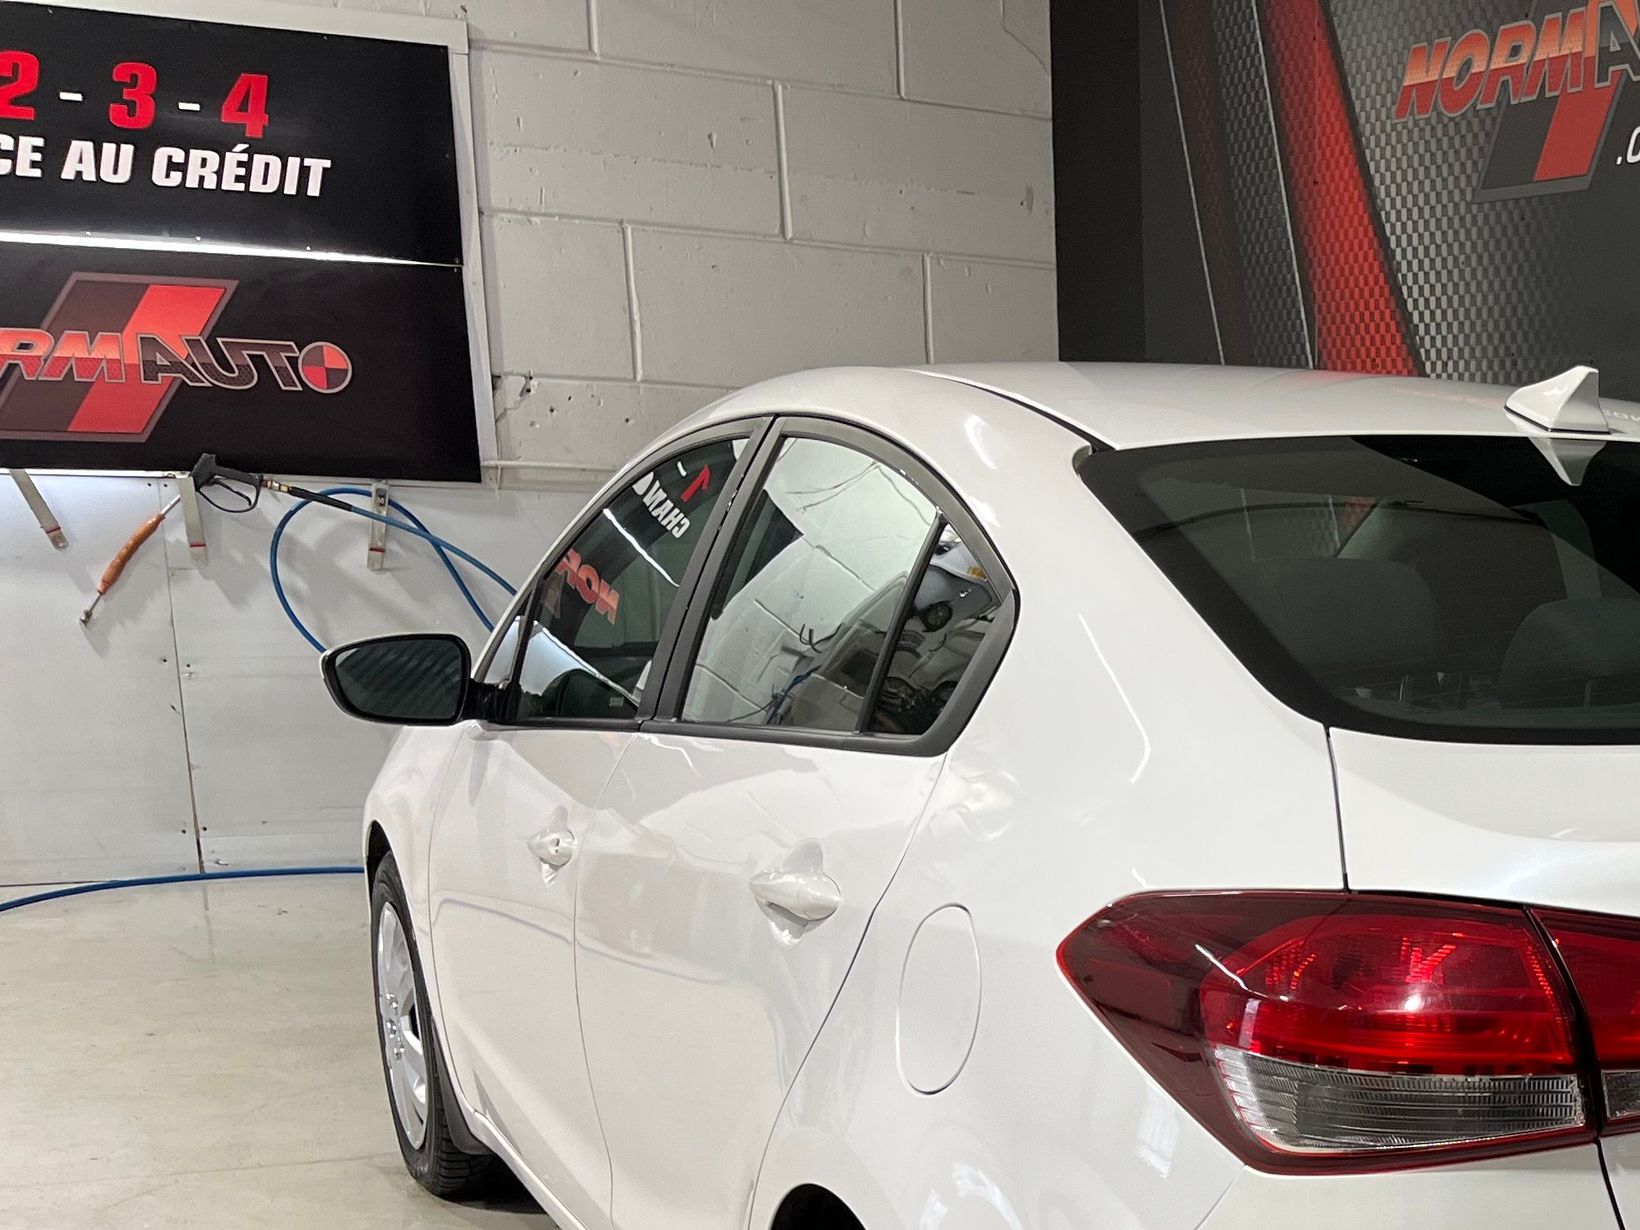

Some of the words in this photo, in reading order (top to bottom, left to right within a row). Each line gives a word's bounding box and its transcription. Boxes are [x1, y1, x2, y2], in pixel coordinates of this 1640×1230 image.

[108, 62, 157, 130] 3
[220, 73, 269, 139] 4
[60, 139, 135, 184] AU
[151, 143, 332, 197] CRÉDIT
